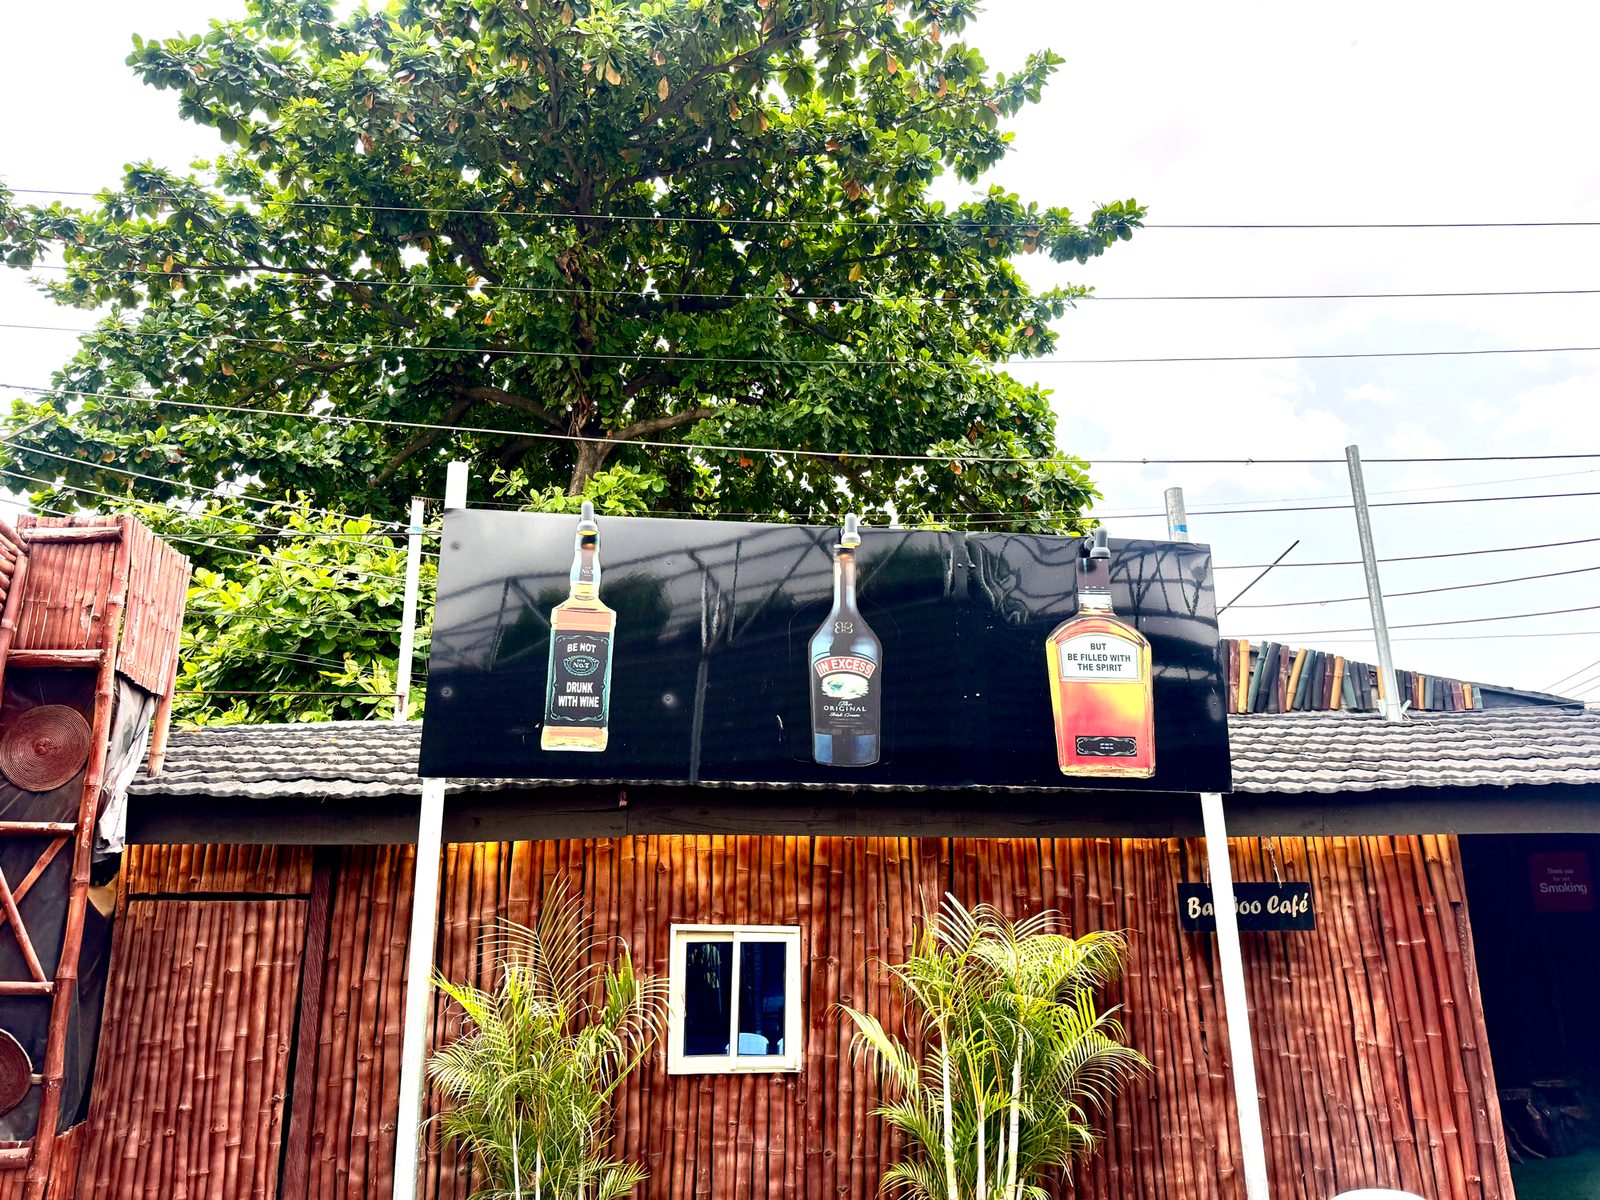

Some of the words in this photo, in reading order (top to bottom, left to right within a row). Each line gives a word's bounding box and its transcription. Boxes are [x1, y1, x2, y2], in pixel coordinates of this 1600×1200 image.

[567, 643, 578, 653] BE
[580, 642, 596, 653] NOT
[1068, 653, 1078, 661] BE
[1110, 654, 1131, 662] WITH
[818, 662, 829, 674] IN
[831, 659, 872, 674] EXCESS
[1077, 663, 1093, 671] THE
[1096, 663, 1122, 671] SPIRIT
[566, 682, 593, 693] DRUNK
[558, 695, 578, 707] WITH
[580, 696, 599, 707] WINE
[1540, 882, 1587, 895] Smoking
[1187, 896, 1261, 919] Baoo
[1267, 892, 1308, 918] Café
